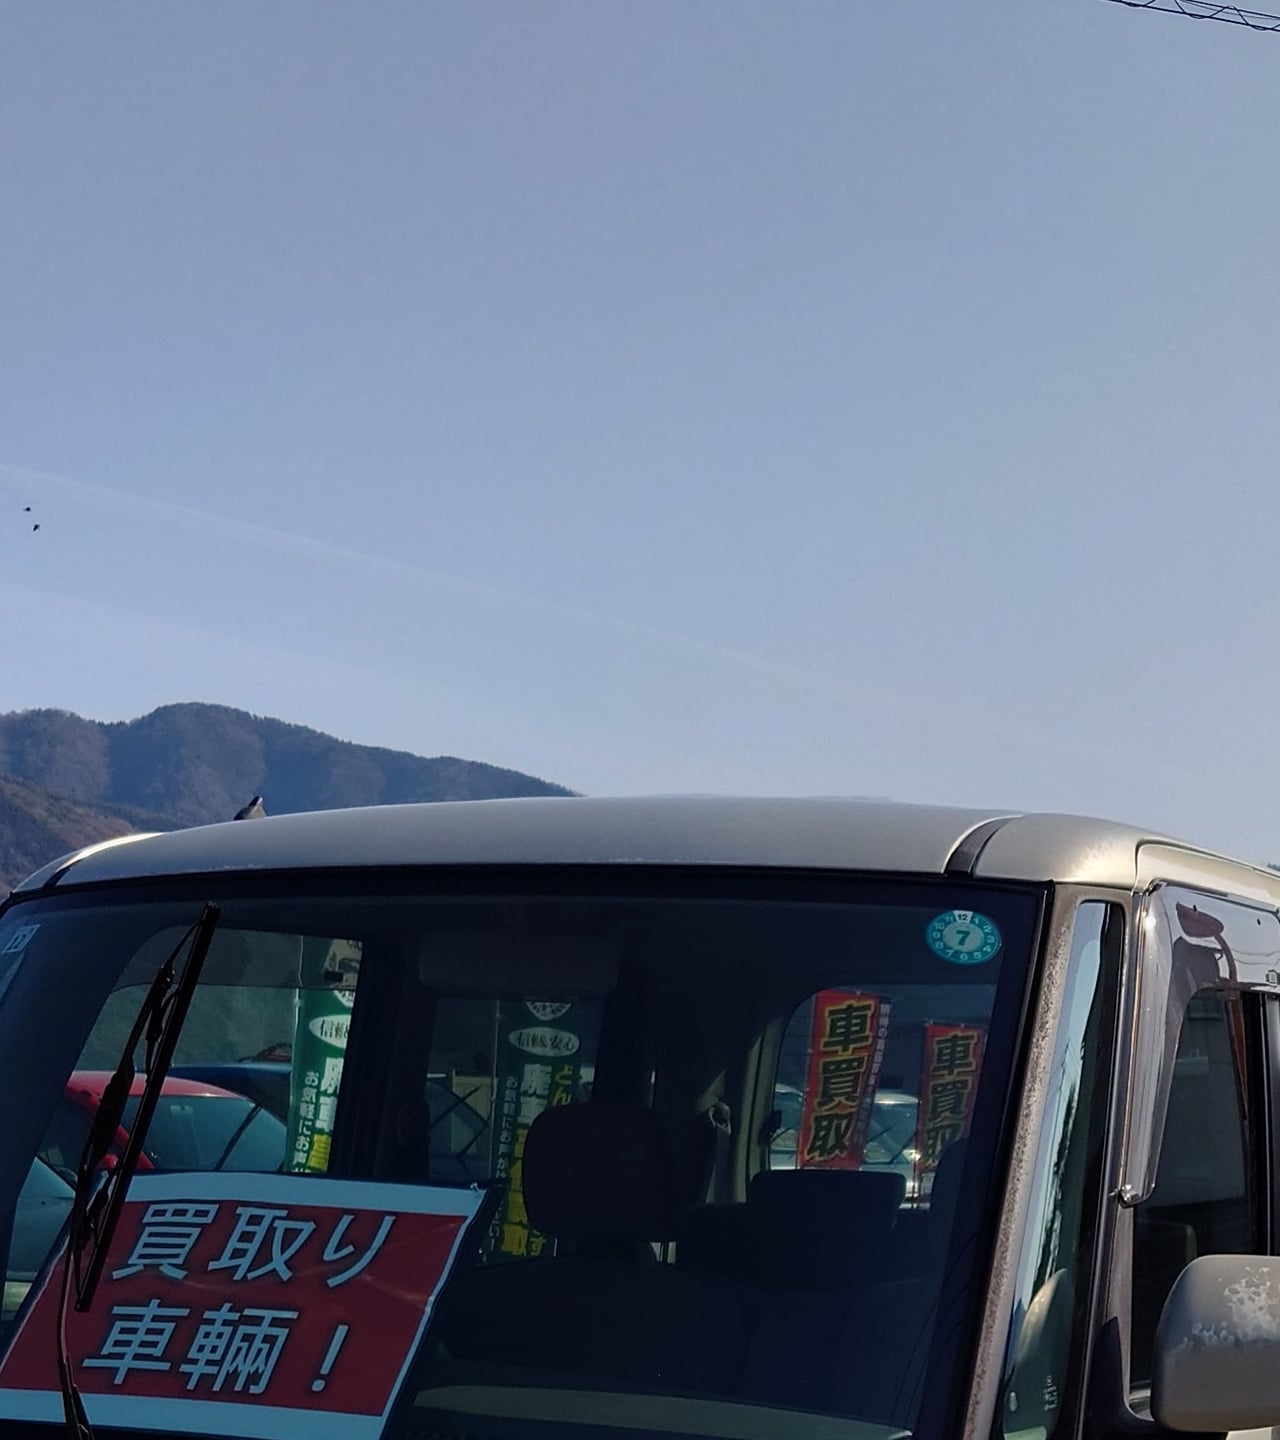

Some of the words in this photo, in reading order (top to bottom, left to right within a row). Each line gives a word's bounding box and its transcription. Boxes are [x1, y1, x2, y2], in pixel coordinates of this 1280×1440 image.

[805, 999, 875, 1161] 車買取
[112, 1202, 397, 1288] 買取り
